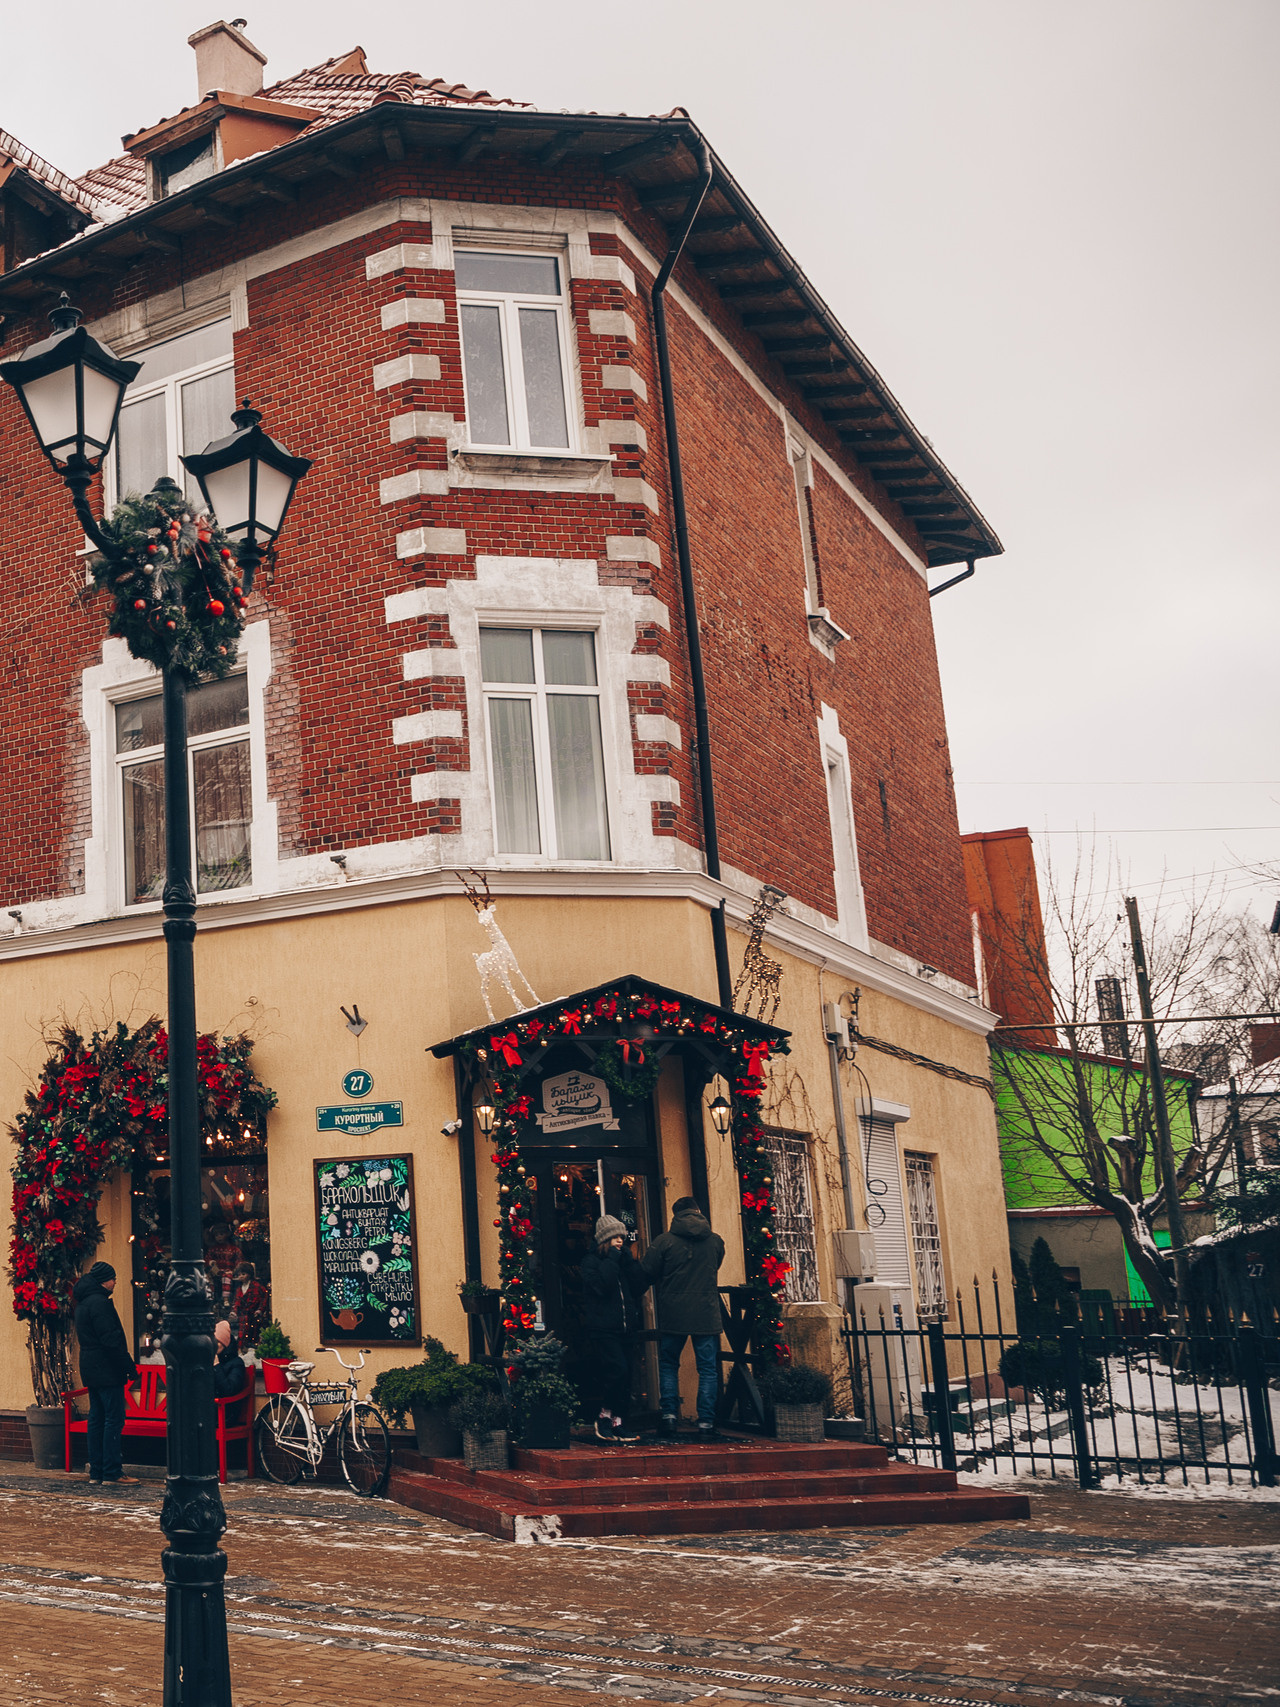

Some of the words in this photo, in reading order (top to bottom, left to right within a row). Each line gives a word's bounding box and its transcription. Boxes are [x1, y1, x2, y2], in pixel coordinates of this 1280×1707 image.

[350, 1075, 364, 1091] 27
[550, 1082, 595, 1098] Барахо
[335, 1111, 384, 1124] КУРОРТНЫЙ
[322, 1184, 400, 1204] БАРАХОЛЬЩИК
[341, 1207, 389, 1219] АНТИКВАРИАТ
[358, 1218, 388, 1227] ВИНТАЖ
[364, 1226, 387, 1237] РЕТРО
[323, 1250, 361, 1261] ШОКОЛАД
[1247, 1263, 1264, 1277] 27
[367, 1271, 413, 1284] СУВЕНИРЫ
[370, 1282, 414, 1293] ОТКРЫТКИ
[385, 1291, 412, 1302] МЫЛО
